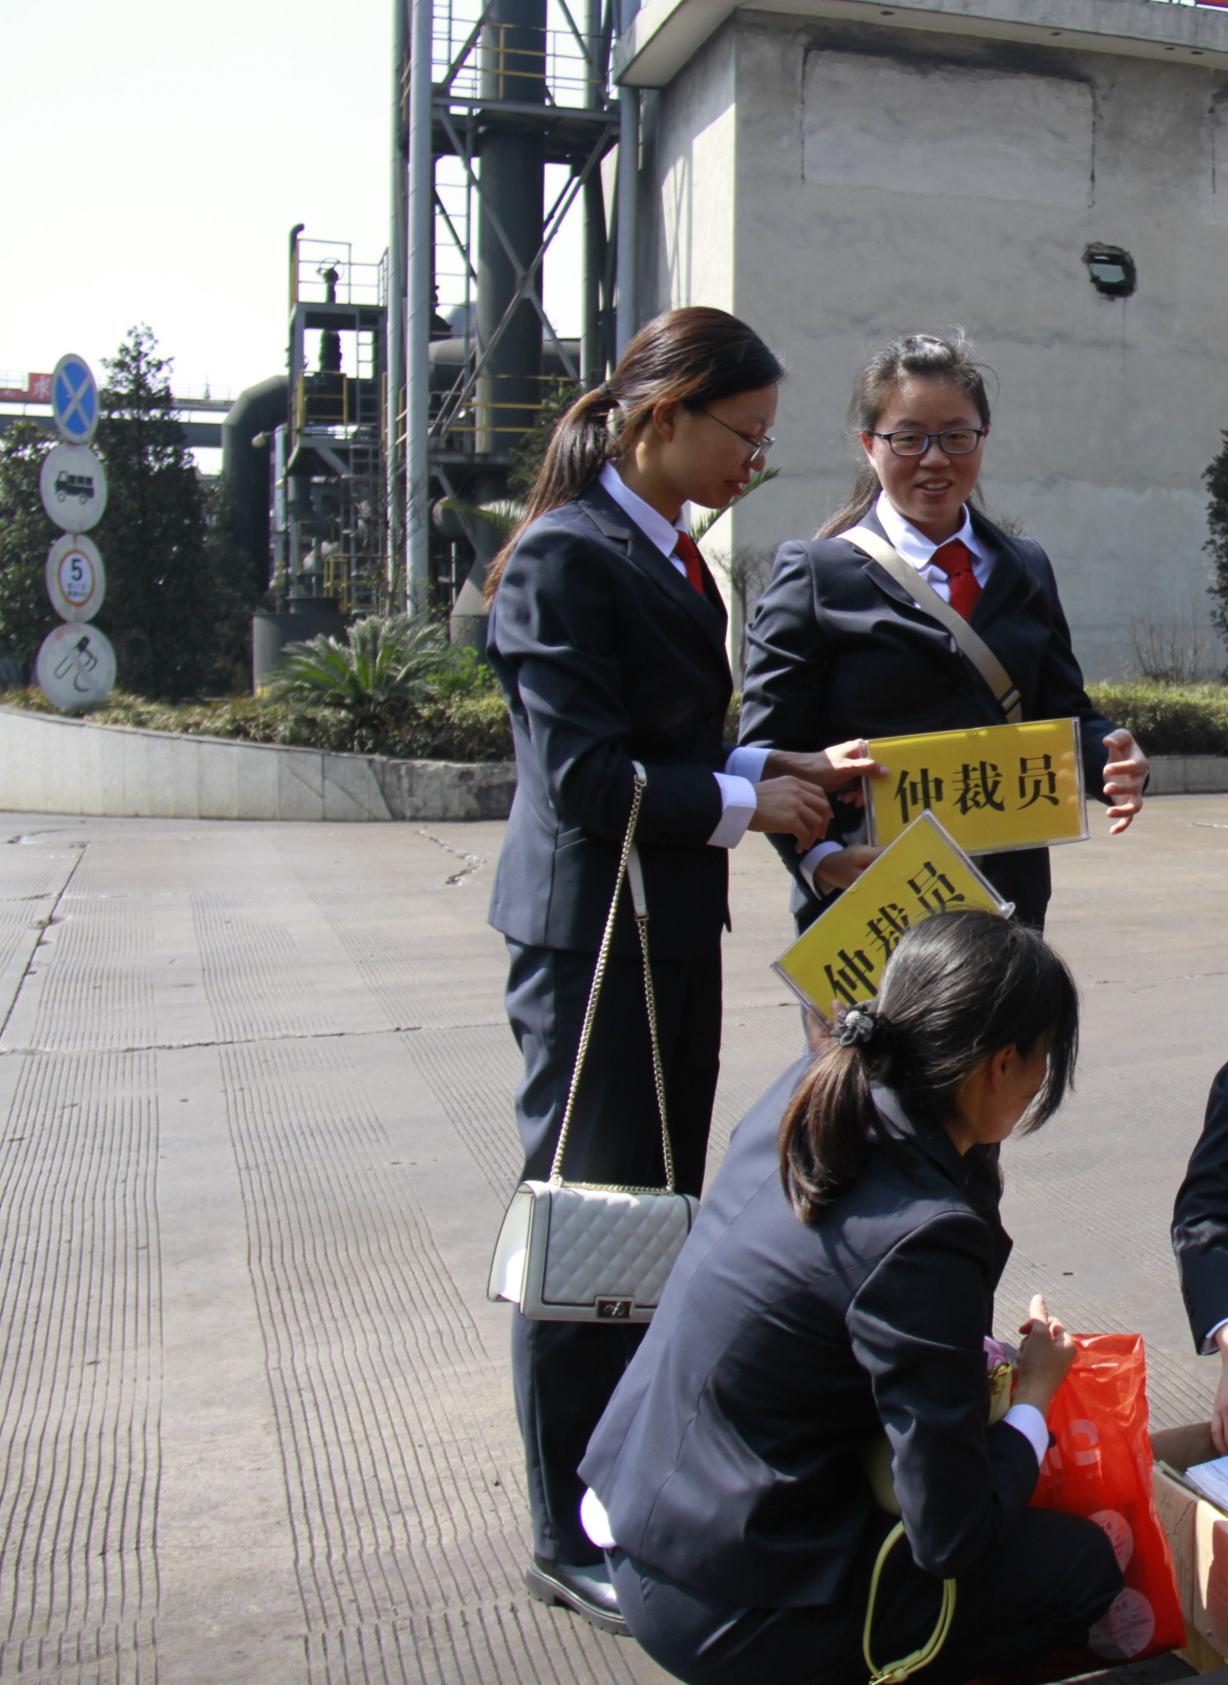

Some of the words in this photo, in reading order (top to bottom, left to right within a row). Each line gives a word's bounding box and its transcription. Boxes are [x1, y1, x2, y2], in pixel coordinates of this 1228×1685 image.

[71, 557, 83, 582] 5
[894, 753, 1061, 825] 仲裁员
